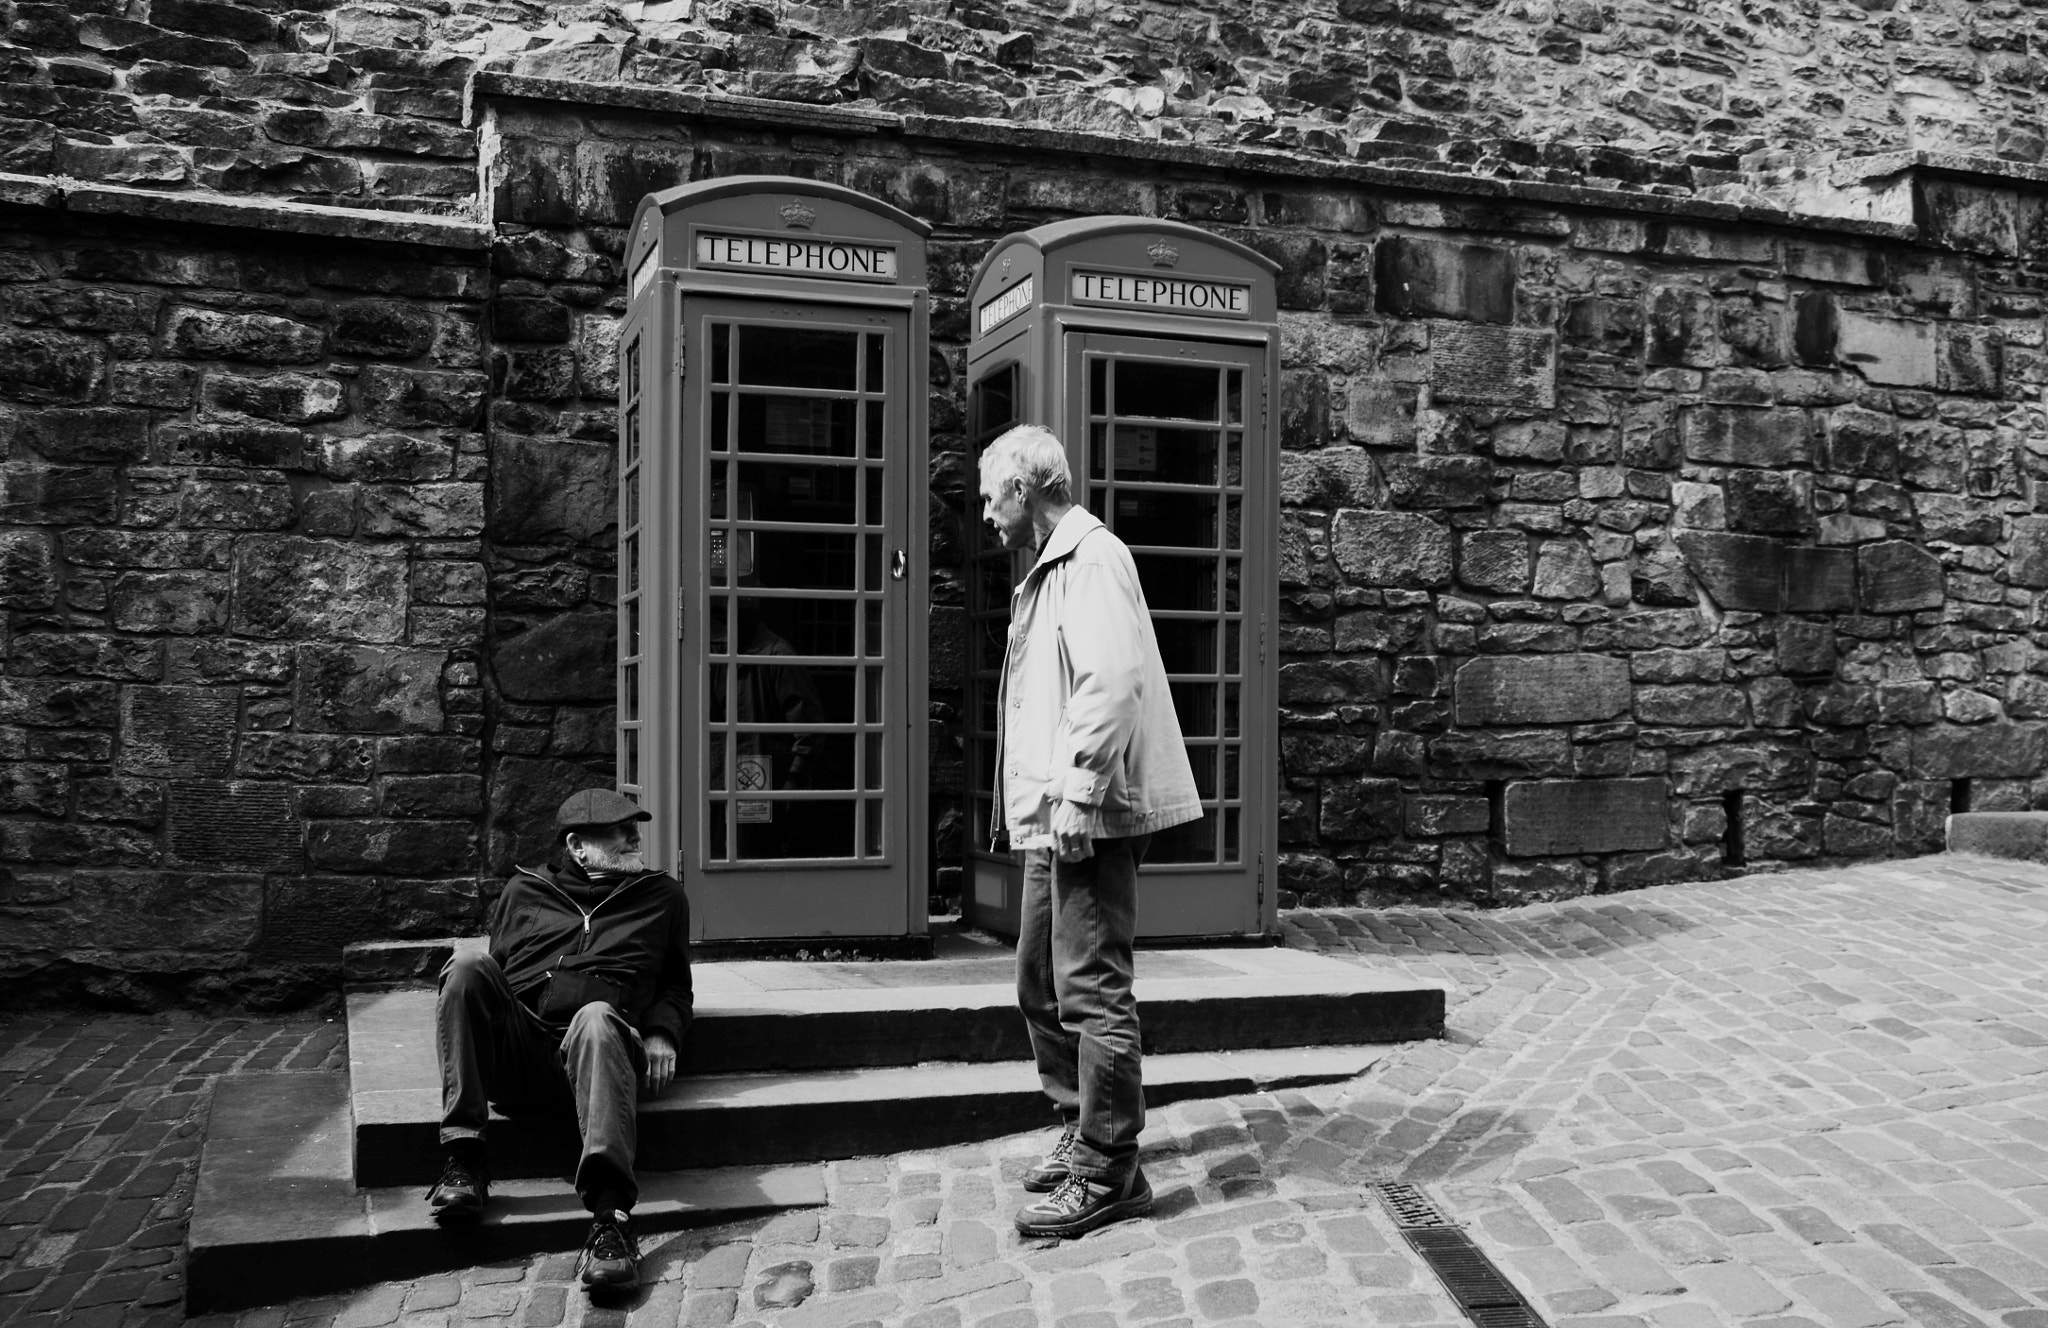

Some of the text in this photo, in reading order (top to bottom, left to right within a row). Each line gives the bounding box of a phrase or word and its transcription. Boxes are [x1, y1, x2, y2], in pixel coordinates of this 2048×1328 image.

[703, 236, 888, 275] TELEPHONE
[983, 279, 1033, 330] TELEPHONE
[1079, 274, 1243, 311] TELEPHONE
